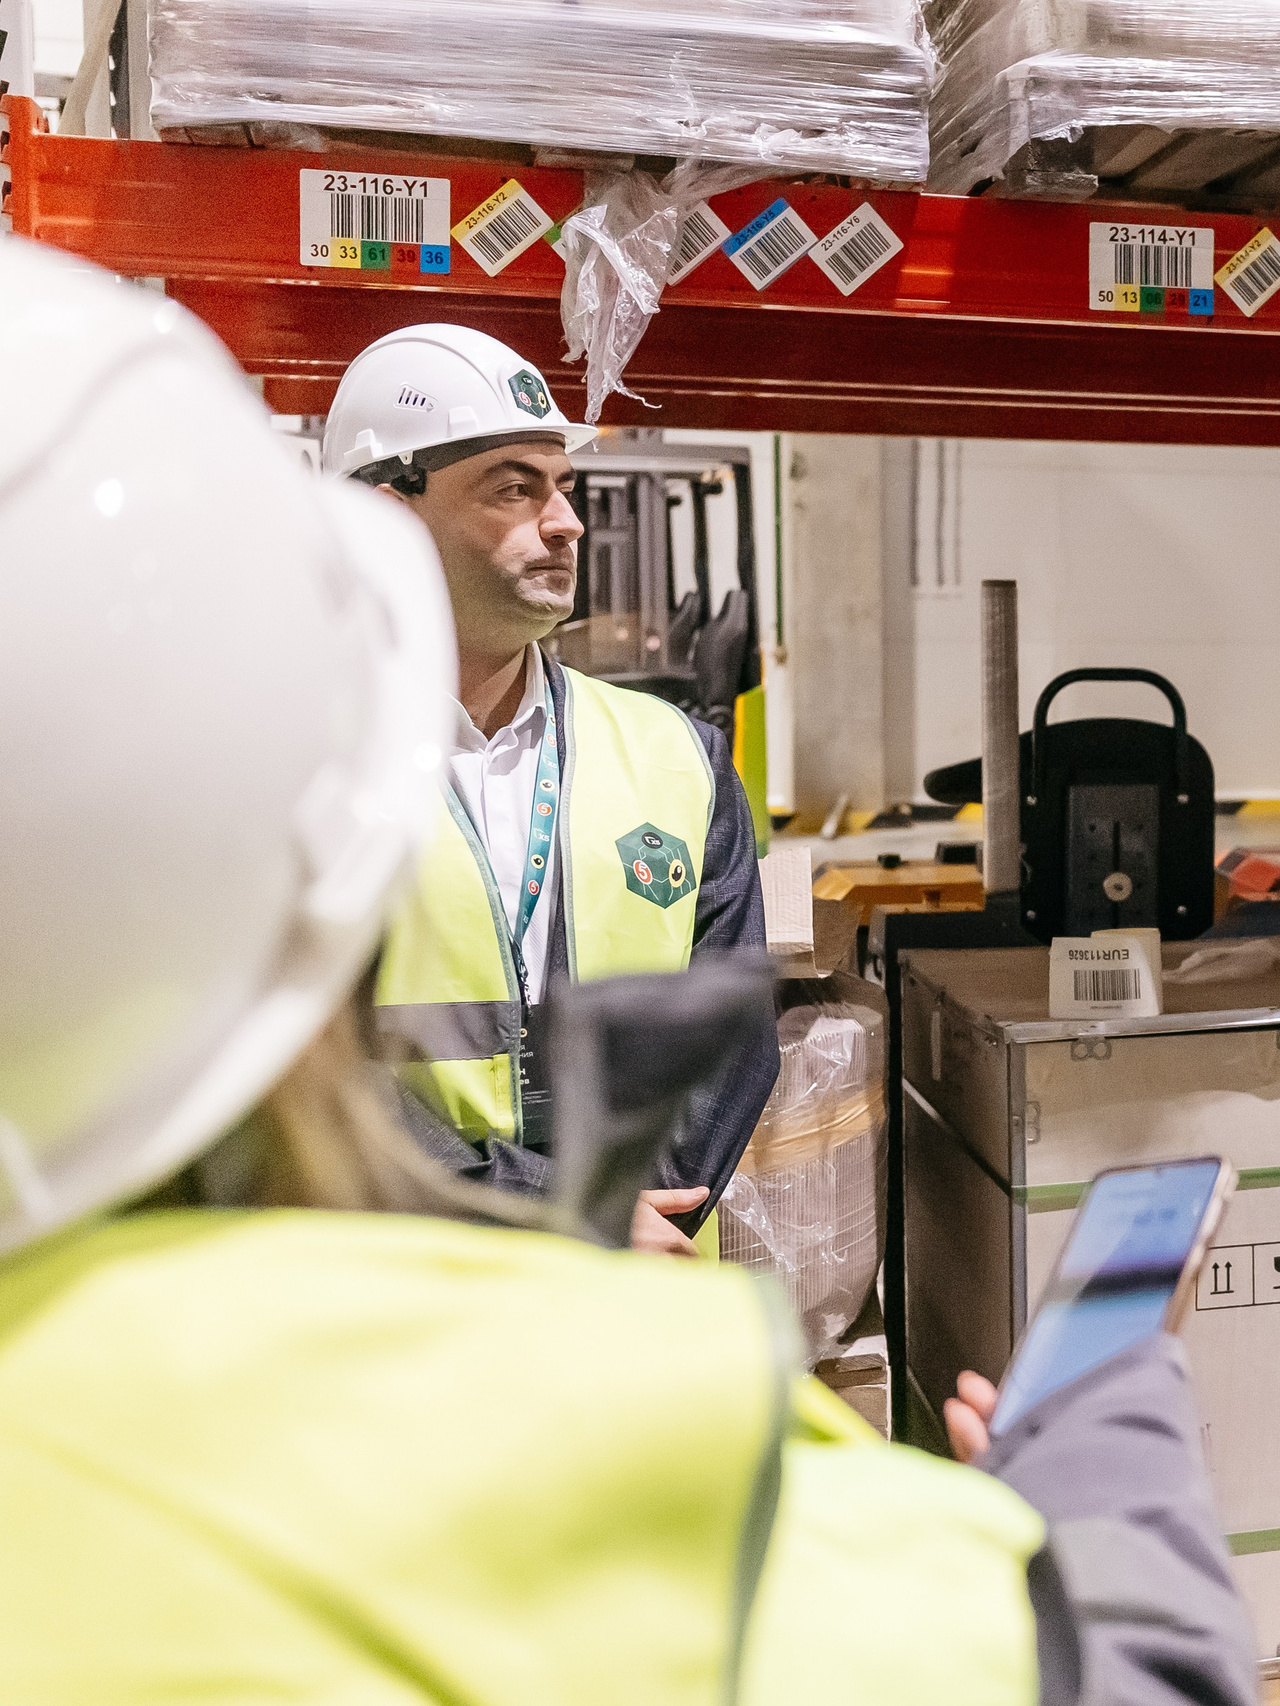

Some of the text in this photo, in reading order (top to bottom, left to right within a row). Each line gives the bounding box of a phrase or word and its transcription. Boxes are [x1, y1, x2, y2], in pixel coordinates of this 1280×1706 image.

[323, 174, 428, 198] 23-116-Y1
[465, 191, 508, 229] 23-116-Y2
[735, 209, 775, 246] 23-116-Y5
[821, 215, 861, 251] 23-116-Y6
[1109, 226, 1196, 246] 23-114-Y1
[310, 244, 444, 265] 30 33 61 39 36
[1226, 239, 1262, 274] 23-114-Y2
[1098, 290, 1114, 303] 50
[1122, 291, 1138, 304] 13
[1193, 294, 1208, 307] 21
[1068, 949, 1130, 961] EUR113626
